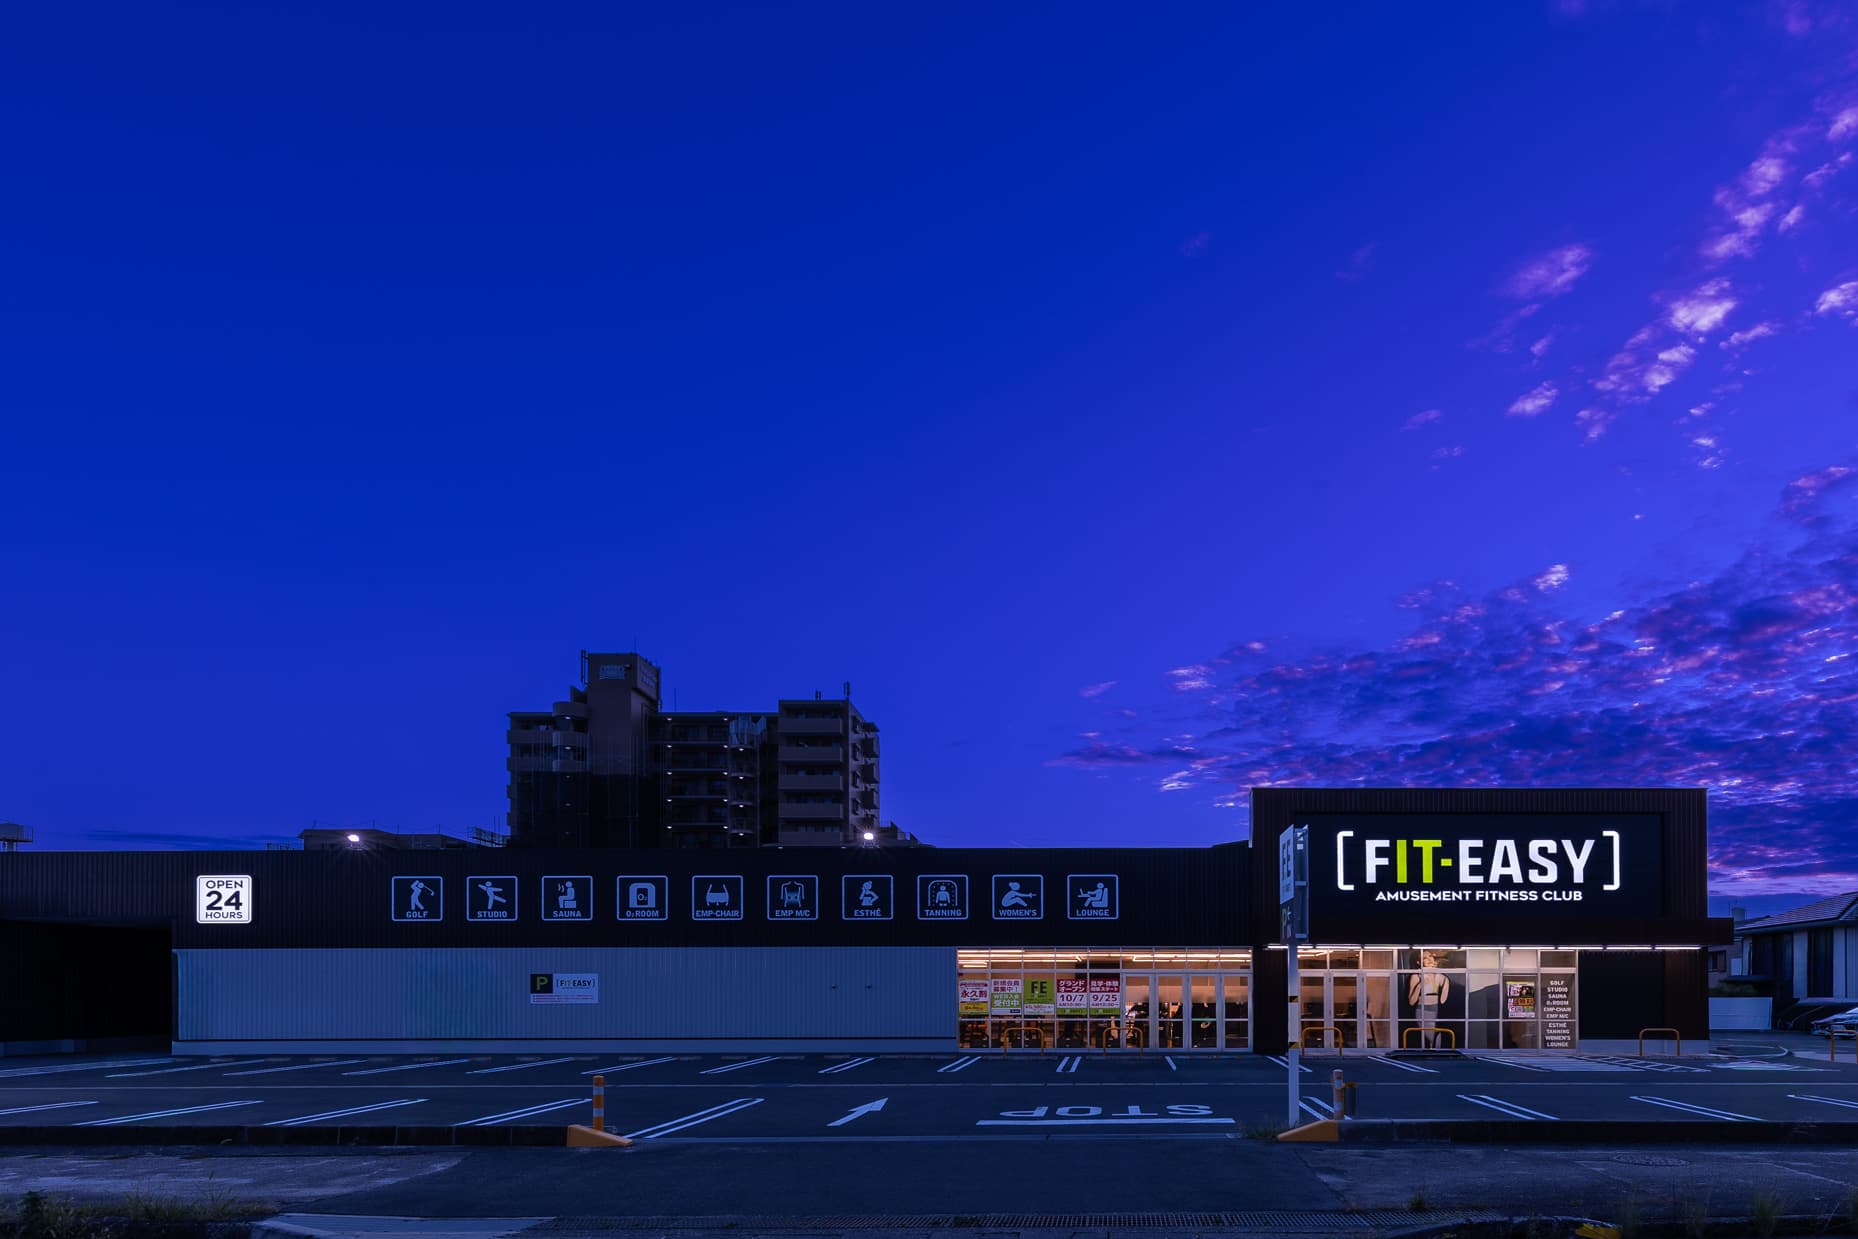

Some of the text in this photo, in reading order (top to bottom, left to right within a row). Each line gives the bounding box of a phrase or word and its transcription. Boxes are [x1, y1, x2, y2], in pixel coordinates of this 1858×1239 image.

[205, 879, 243, 889] OPEN
[1375, 890, 1583, 901] AMUSEMENT FITNESS CLUB
[206, 890, 243, 911] 24
[205, 911, 243, 919] HOURS
[405, 911, 429, 919] GOLF
[476, 911, 508, 919] STUDIO
[552, 910, 582, 918] SAUNA
[695, 910, 740, 918] EMP-CHAIR
[924, 909, 962, 917] TANNING
[998, 909, 1038, 917] WOMEN'S
[1075, 909, 1110, 917] LOUNGE
[535, 976, 548, 991] P
[1059, 994, 1084, 1002] 10/7
[1092, 994, 1118, 1002] 9/25
[999, 1104, 1214, 1117] STOP
